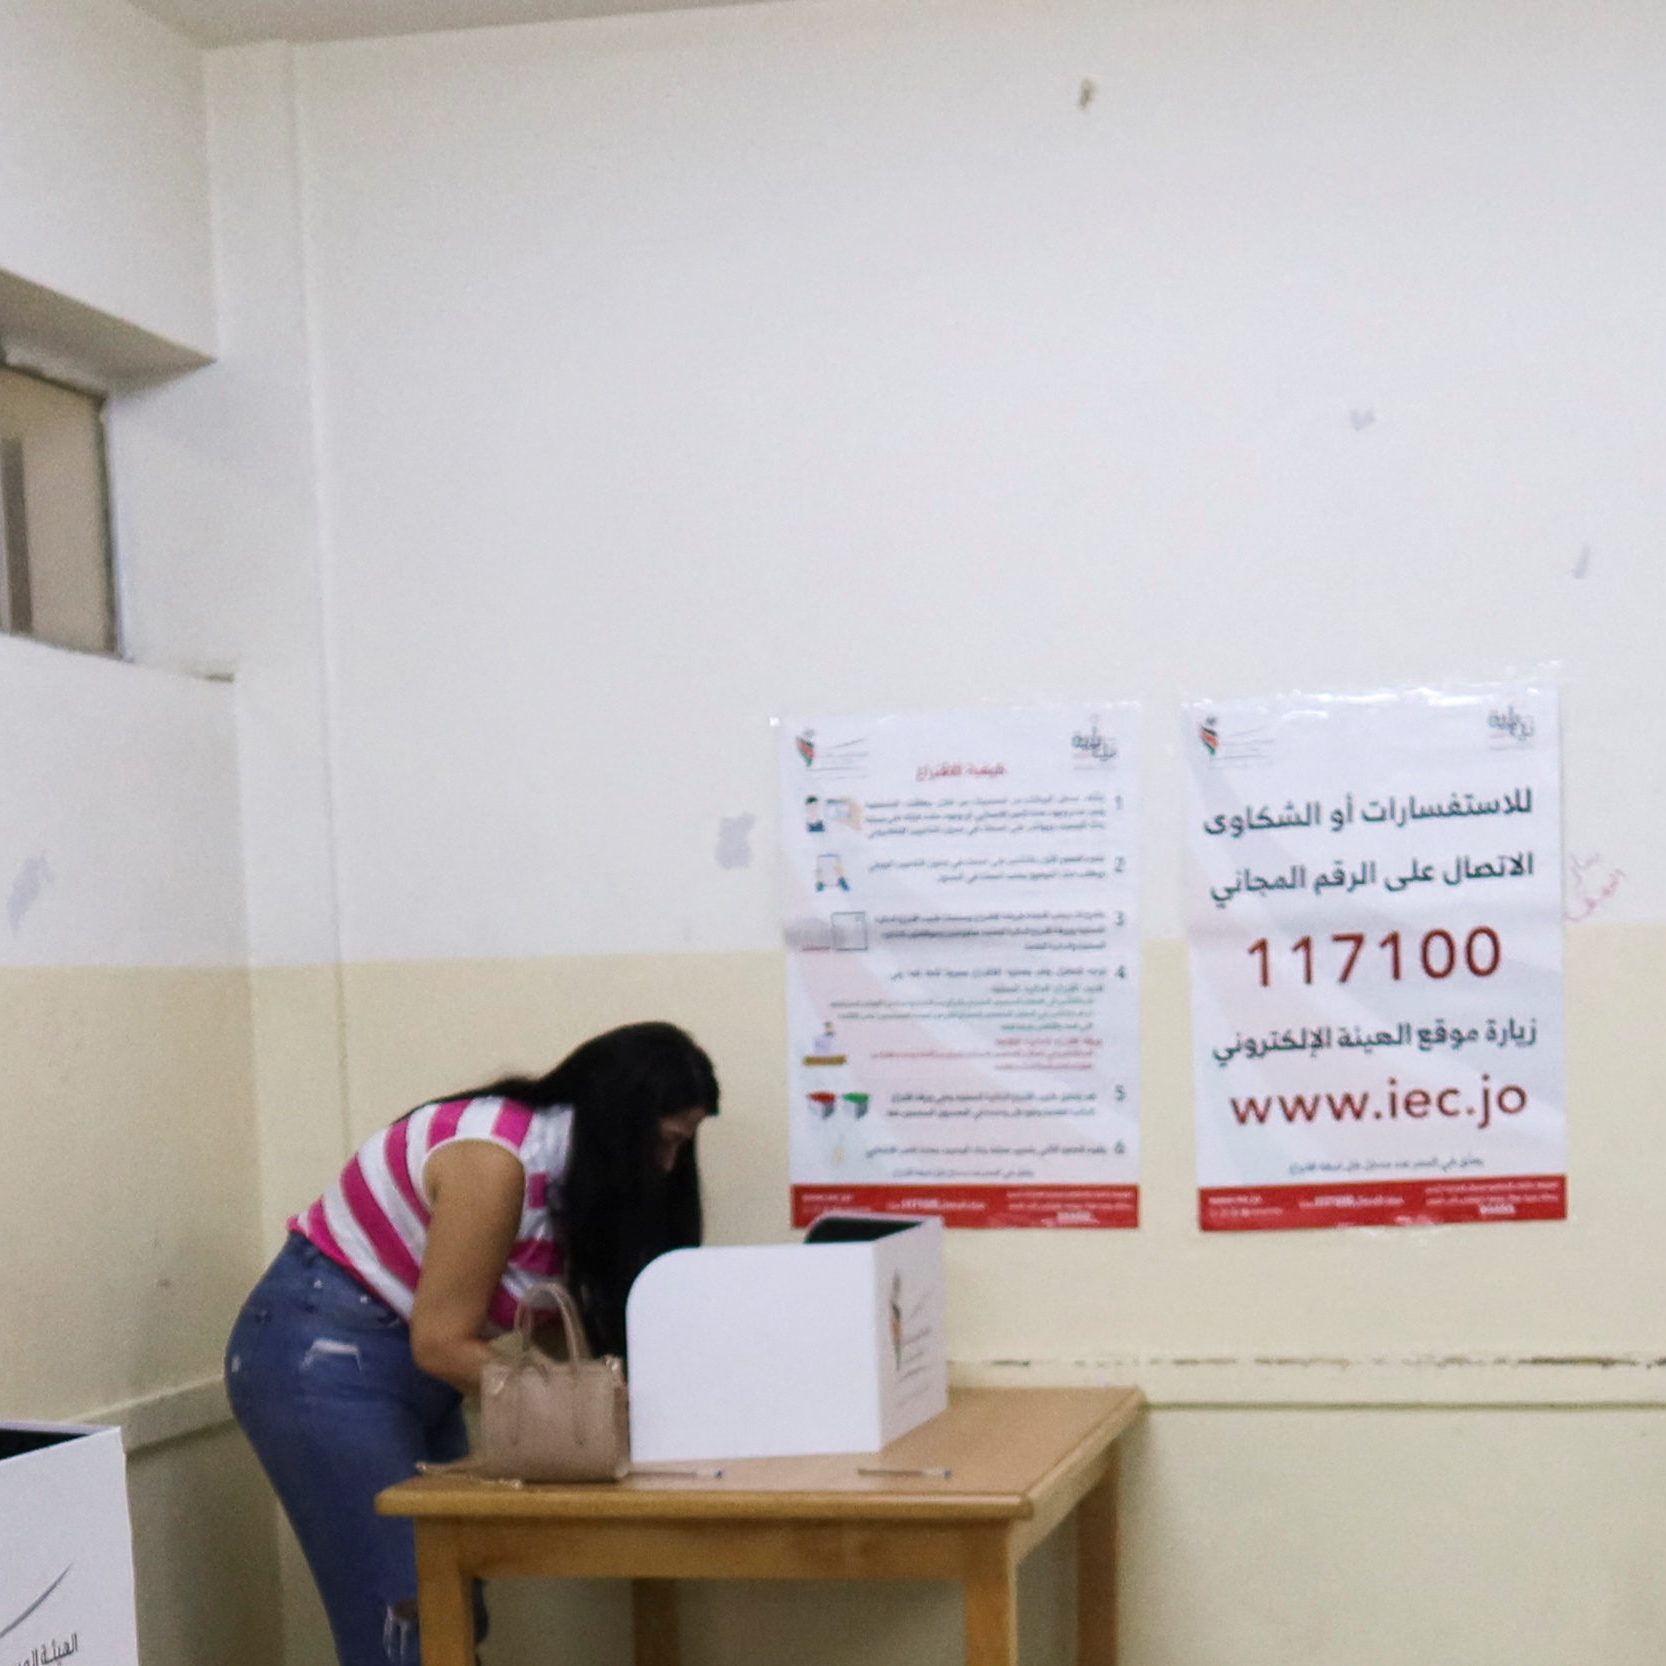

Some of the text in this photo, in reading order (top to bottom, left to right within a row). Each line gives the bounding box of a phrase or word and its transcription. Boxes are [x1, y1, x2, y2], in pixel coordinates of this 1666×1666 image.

[1204, 787, 1533, 838] للاستفسارات أو الشكاوى
[1211, 851, 1533, 909] الاتصال على الرقم المجاني
[1247, 926, 1502, 988] 117100
[1211, 1026, 1331, 1068] الإلكتروني
[1417, 1023, 1479, 1052] موقع
[1484, 1018, 1538, 1048] زيارة
[1229, 1074, 1527, 1129] www.iec.jo
[41, 1632, 78, 1666] الهيئة
